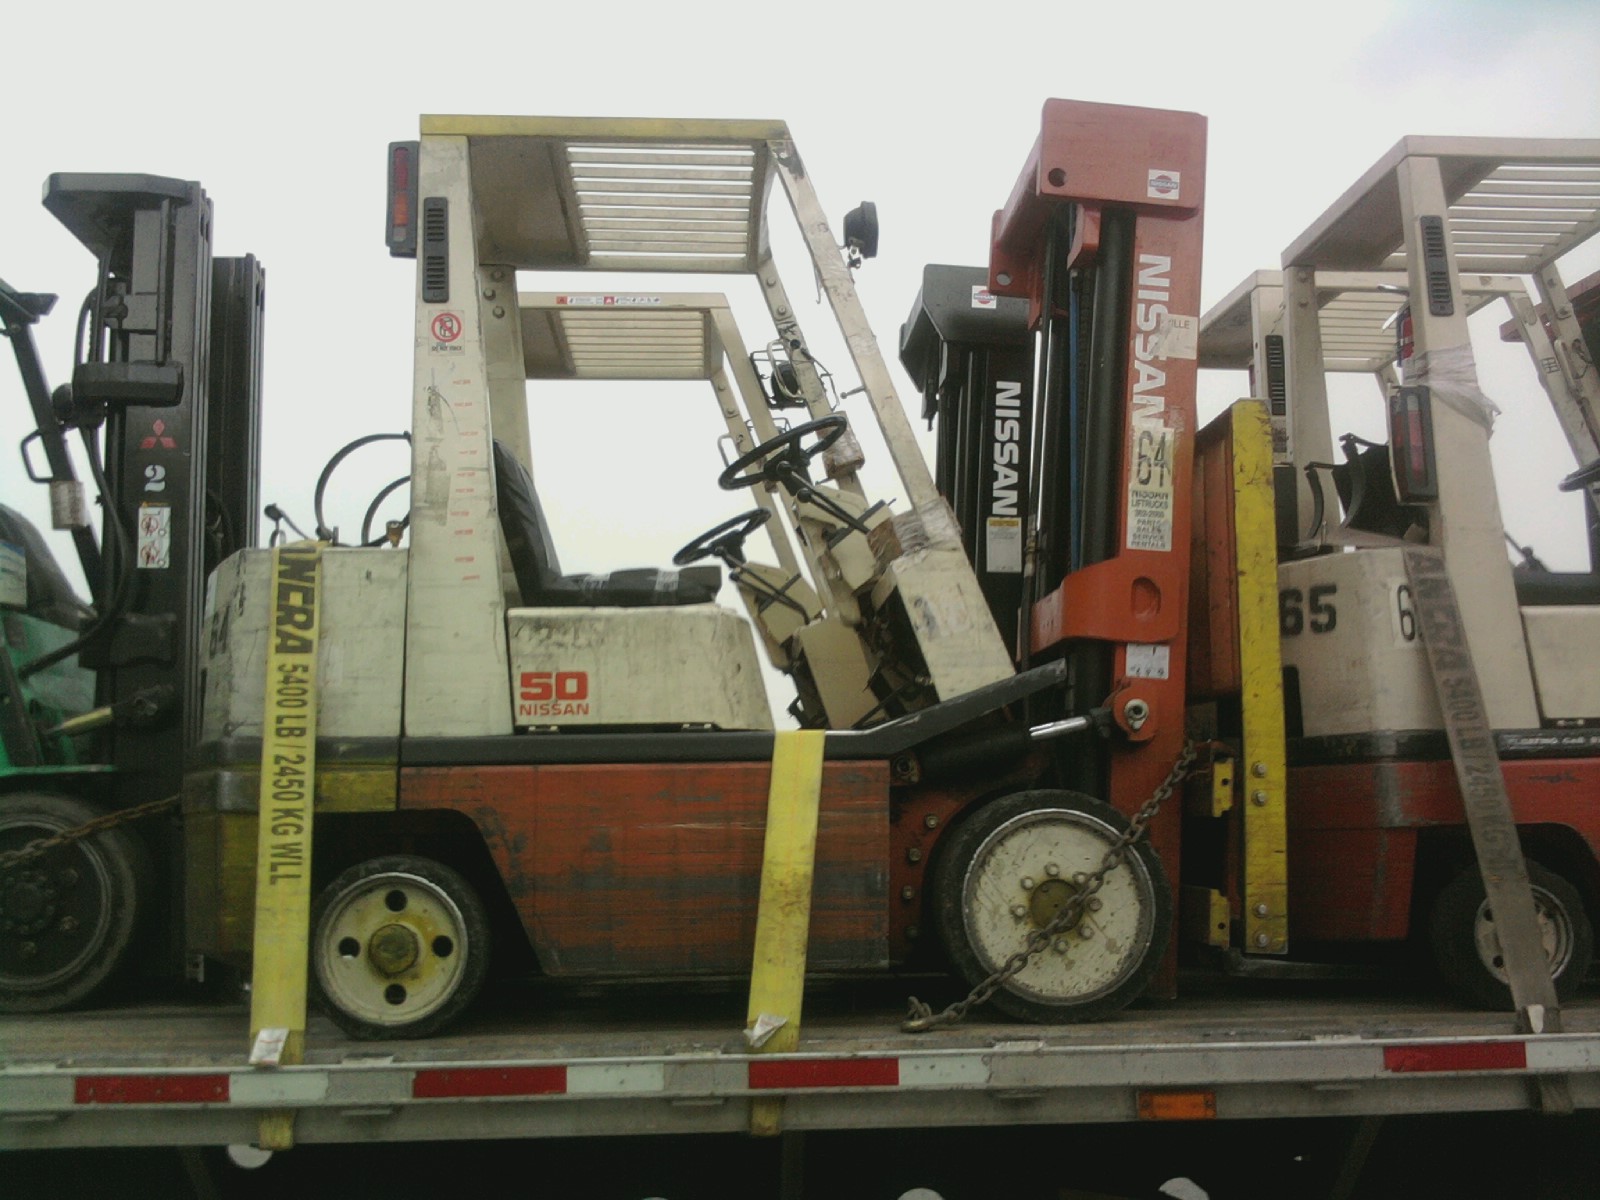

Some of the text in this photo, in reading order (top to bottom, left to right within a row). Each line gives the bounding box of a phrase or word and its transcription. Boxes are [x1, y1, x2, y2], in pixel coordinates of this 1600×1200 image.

[1132, 253, 1171, 428] NISSAN
[992, 381, 1021, 516] NISSAN
[1137, 430, 1171, 487] 64
[144, 464, 167, 492] 2
[275, 663, 309, 708] 5400
[520, 672, 588, 700] 50
[275, 714, 307, 738] LB
[520, 703, 589, 716] NISSAN
[272, 754, 306, 801] 2450
[271, 808, 304, 836] KG
[269, 842, 303, 885] WLL
